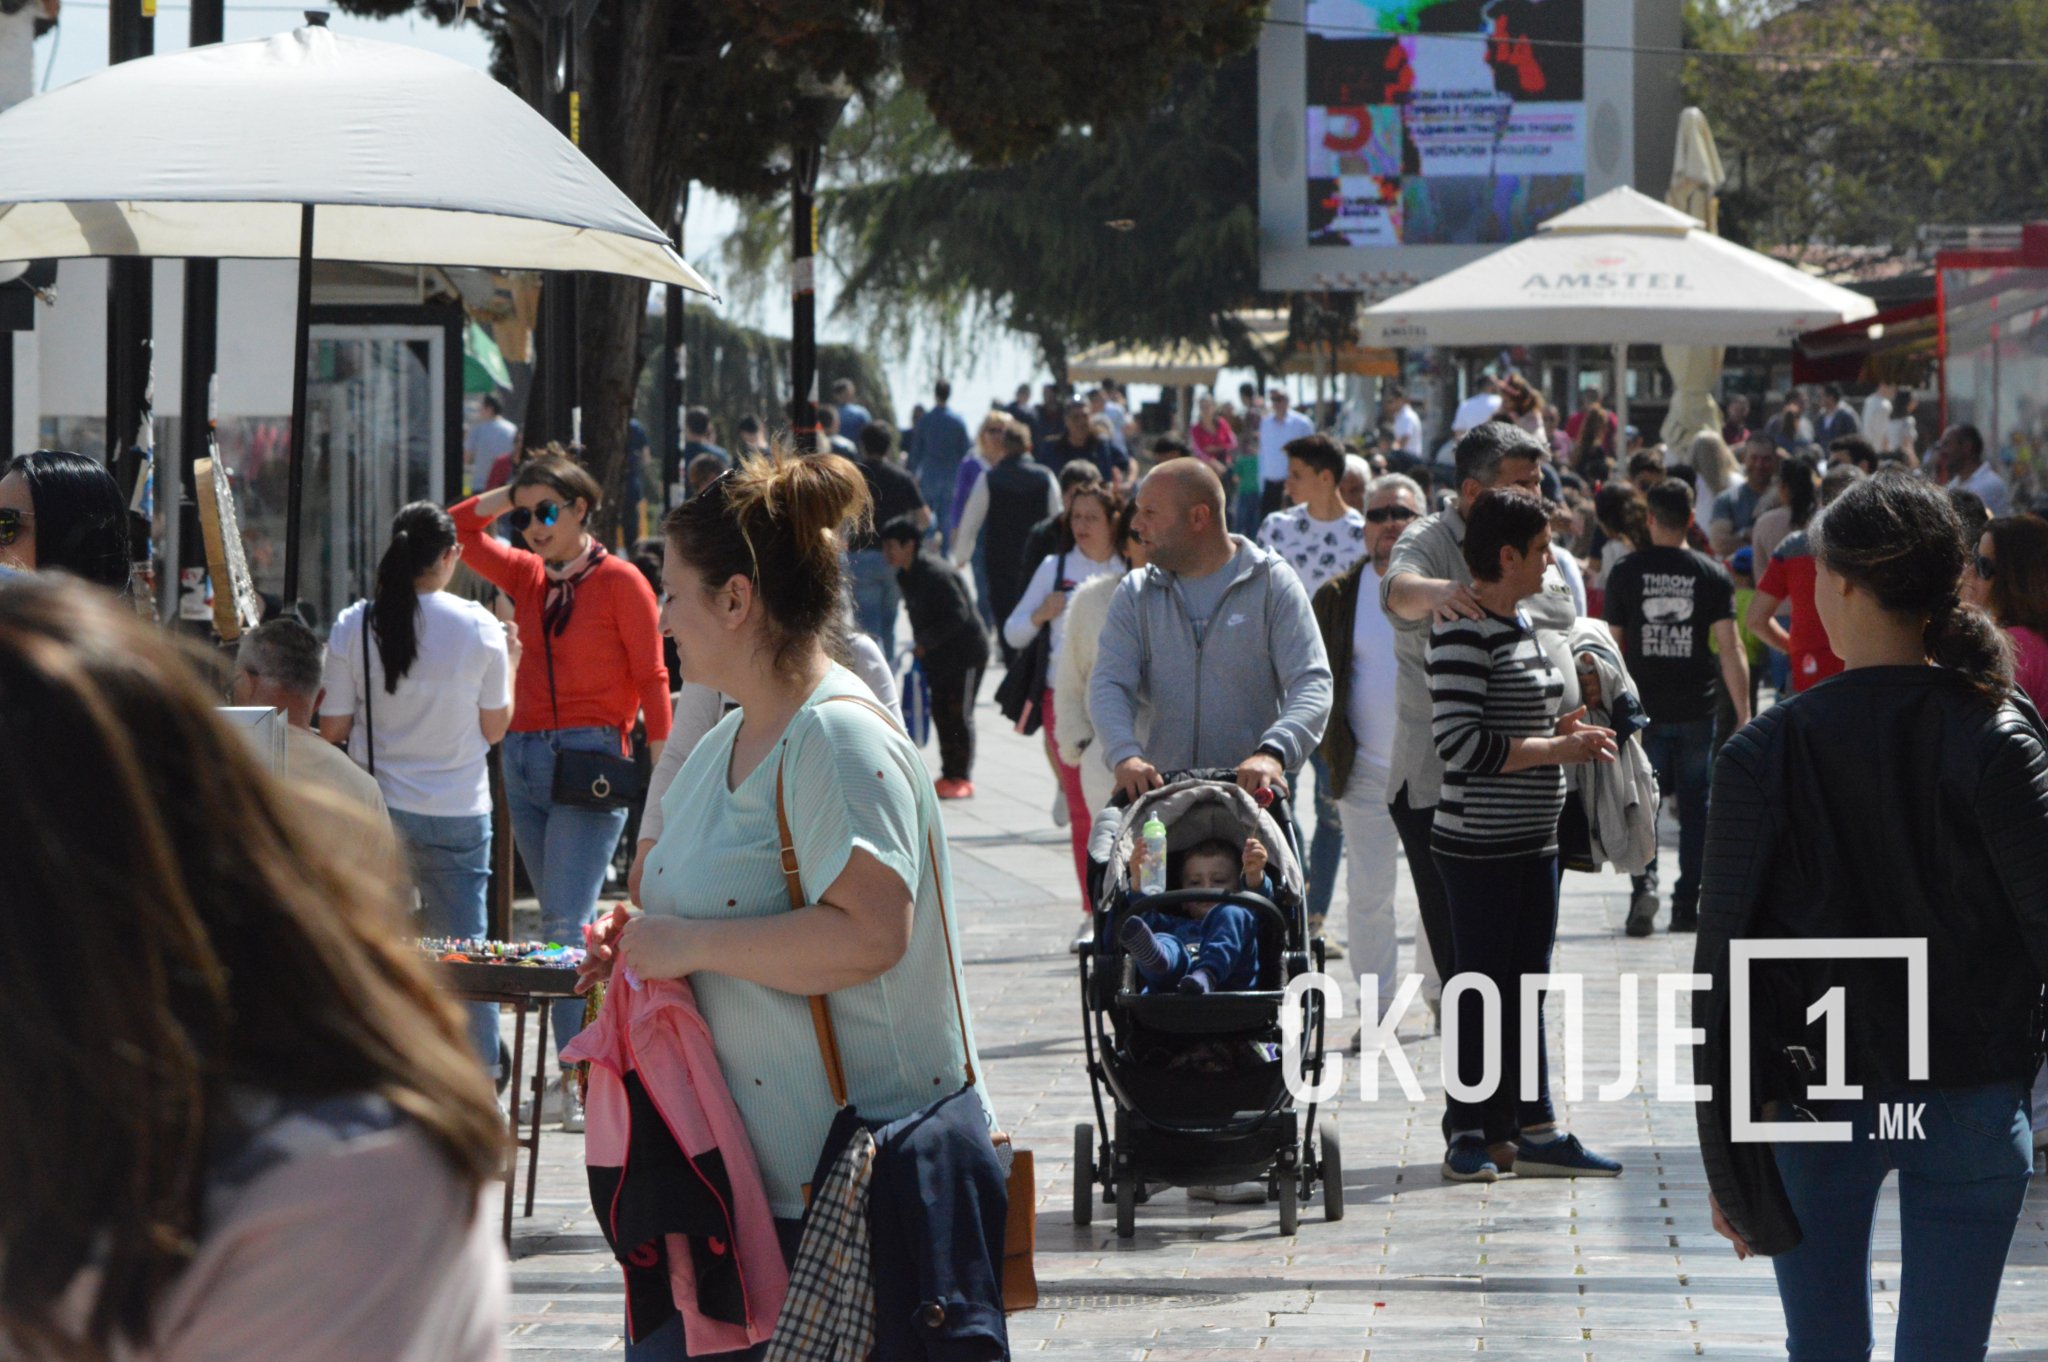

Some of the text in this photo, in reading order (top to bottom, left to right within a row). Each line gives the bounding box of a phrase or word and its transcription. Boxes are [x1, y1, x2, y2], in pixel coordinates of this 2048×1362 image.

[1520, 272, 1695, 290] AMSTEL
[1642, 574, 1696, 588] THROW
[1642, 624, 1693, 639] STEAK
